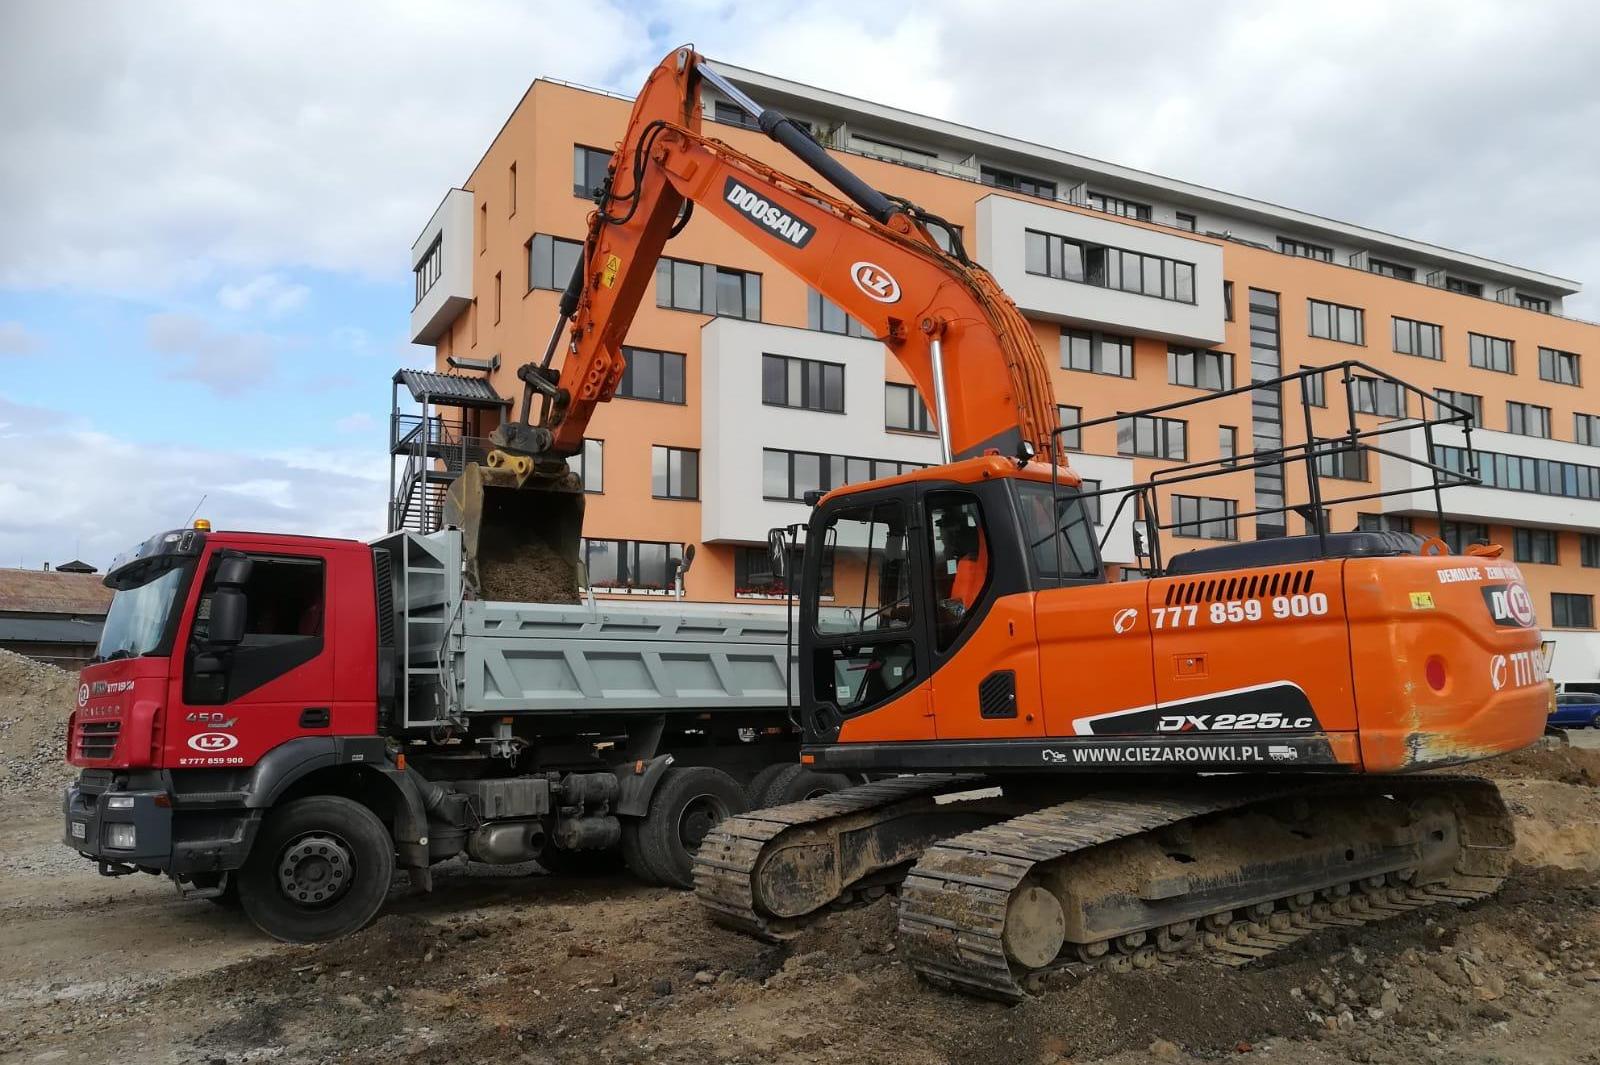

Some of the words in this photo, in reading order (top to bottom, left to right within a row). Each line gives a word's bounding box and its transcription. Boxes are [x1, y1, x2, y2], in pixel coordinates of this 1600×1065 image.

[727, 184, 808, 244] DOOSAN
[861, 269, 892, 296] LZ
[1437, 567, 1482, 583] DEMOLICE
[1151, 605, 1198, 628] 777
[1209, 599, 1262, 624] 859
[1272, 593, 1328, 618] 900
[1510, 652, 1532, 687] 777
[186, 712, 224, 722] 450
[200, 737, 225, 748] LZ
[1073, 746, 1263, 763] WWW.CIEZAROWKI.PL
